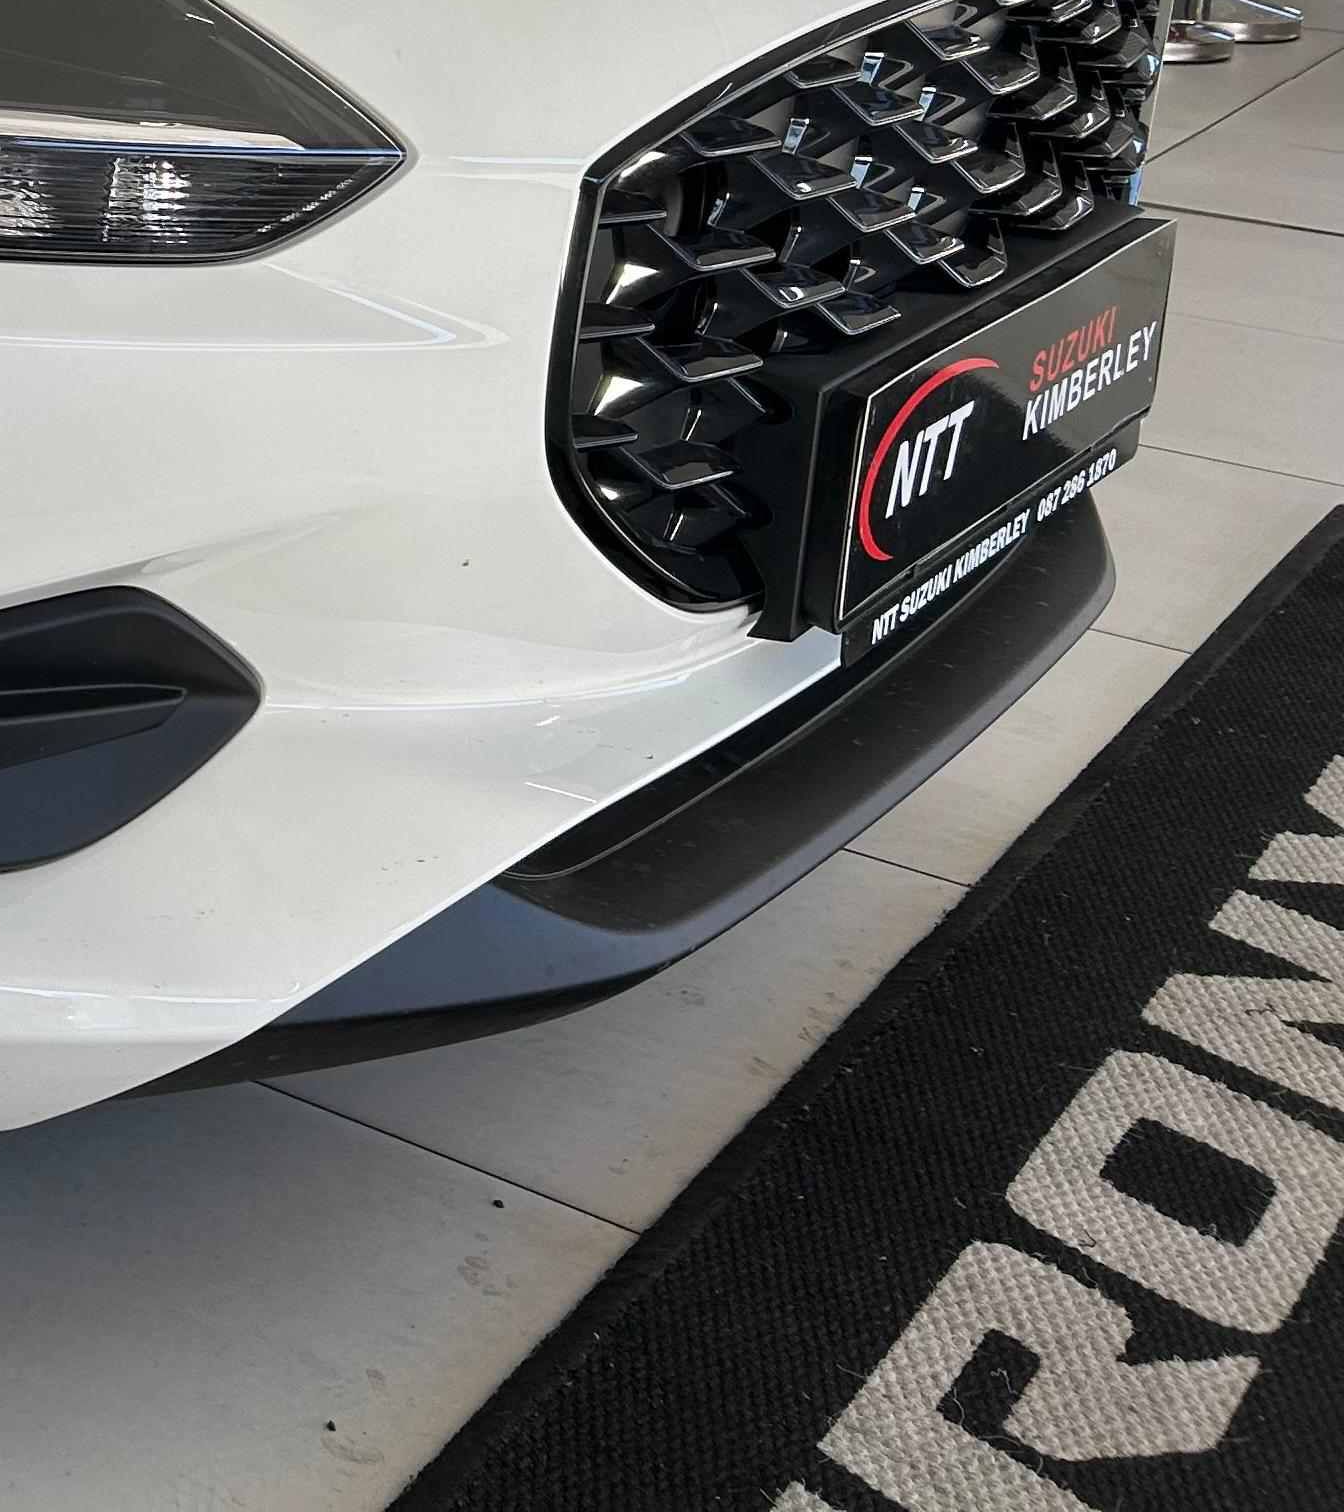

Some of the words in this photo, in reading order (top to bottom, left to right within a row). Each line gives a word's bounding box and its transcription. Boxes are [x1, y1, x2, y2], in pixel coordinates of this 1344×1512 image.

[1022, 320, 1158, 441] KIMBERLEY
[1029, 305, 1118, 393] SUZUKI
[885, 400, 975, 519] NTT
[871, 603, 900, 646] NTT
[899, 565, 953, 623] SUZUKI
[952, 508, 1031, 584] KIMBERLEY
[1036, 486, 1062, 522] 087
[1086, 448, 1117, 488] 1870
